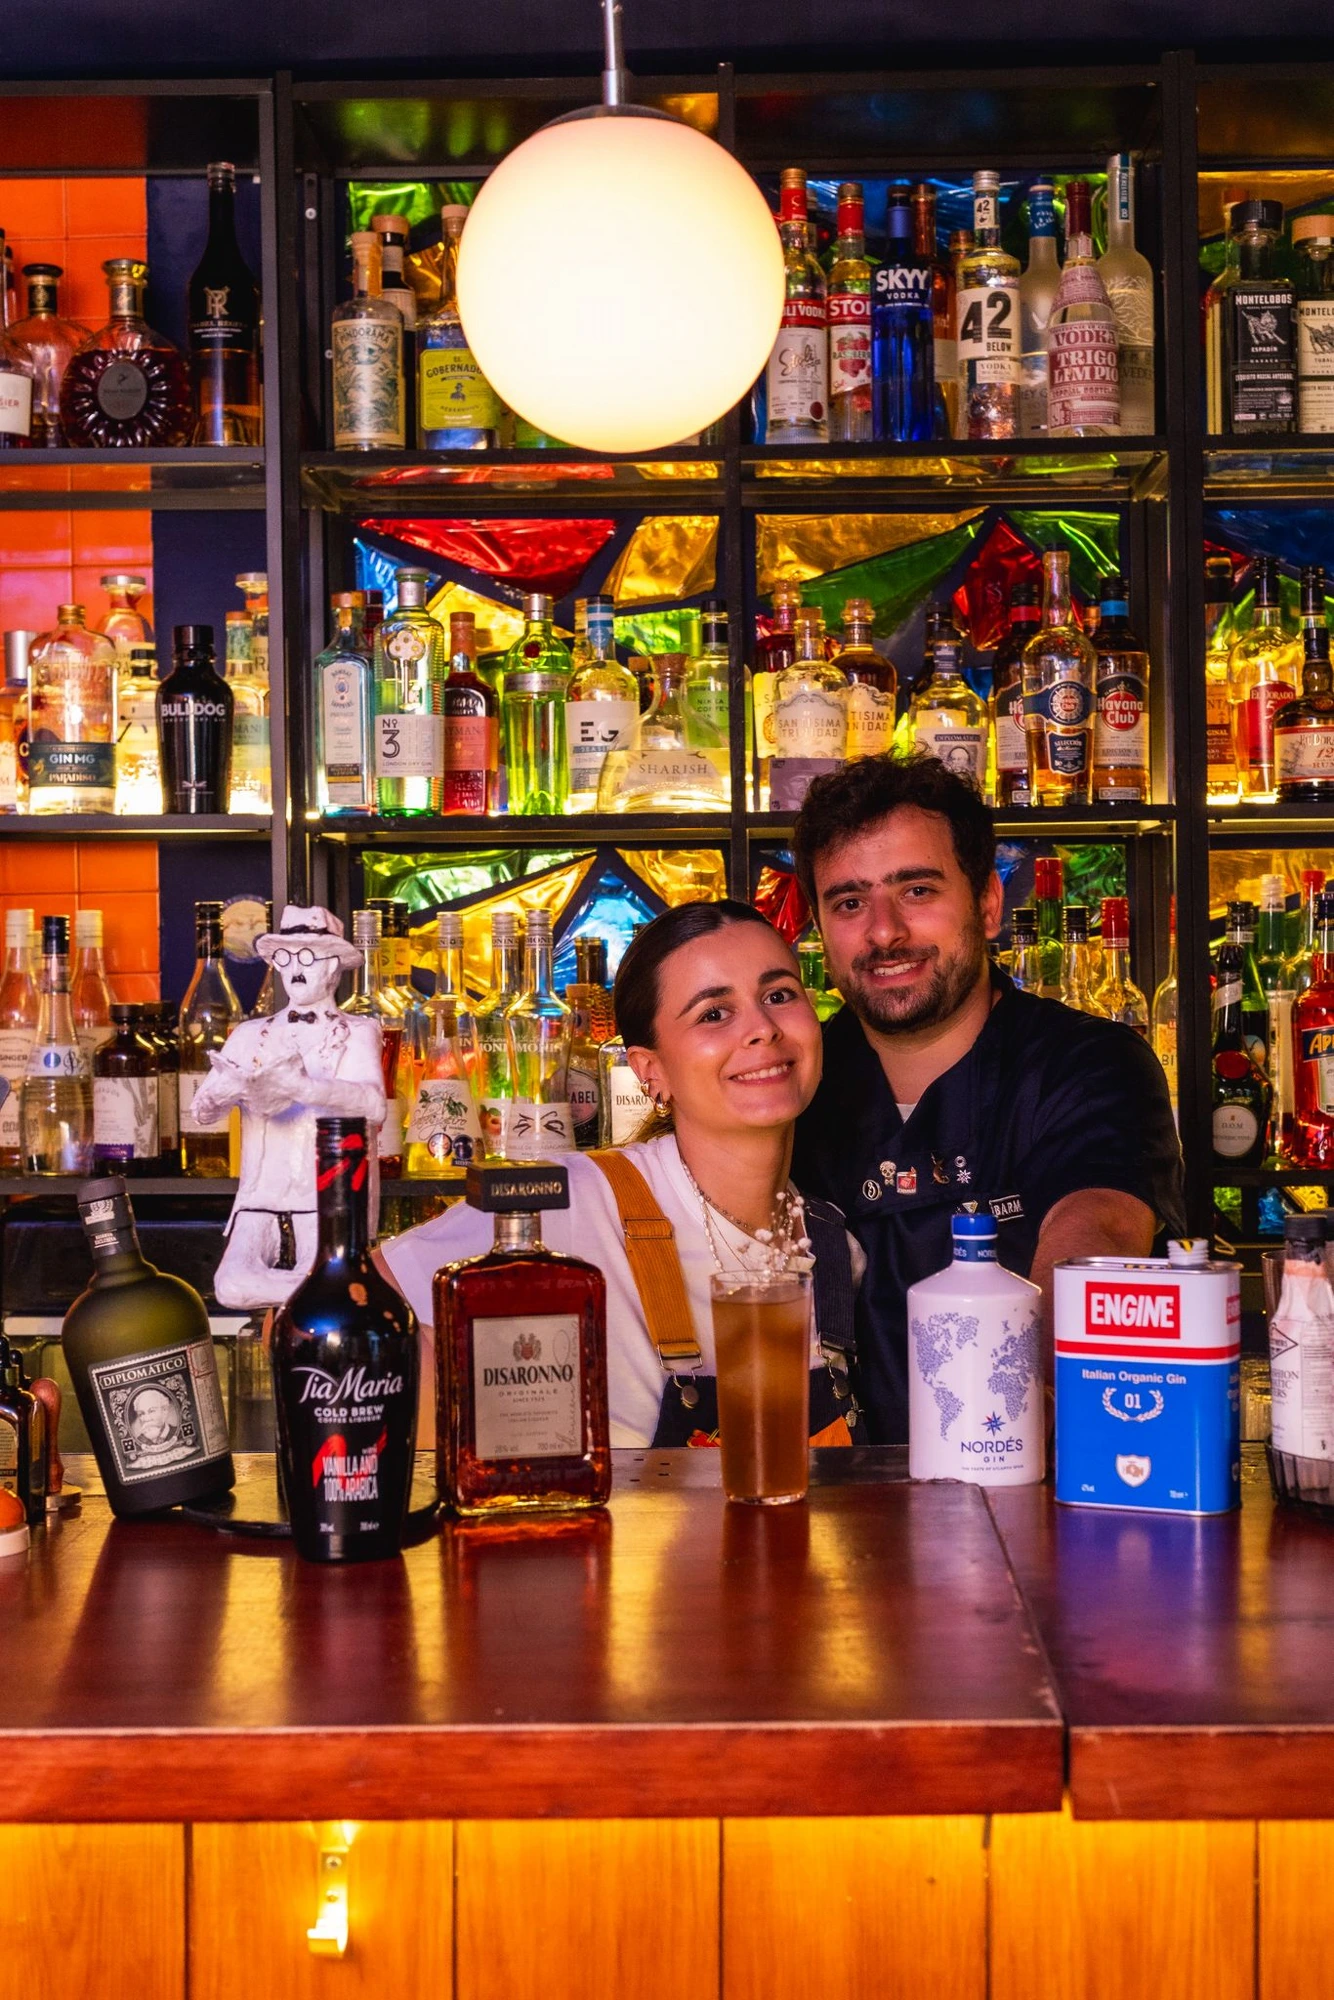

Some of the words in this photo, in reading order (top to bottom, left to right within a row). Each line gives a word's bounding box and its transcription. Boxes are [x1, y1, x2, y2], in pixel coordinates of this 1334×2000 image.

[976, 200, 990, 213] 42
[876, 268, 929, 292] SKYY
[886, 292, 920, 300] VODKA
[1235, 294, 1293, 305] MONTELOBOS
[960, 290, 1013, 343] 42
[1054, 328, 1117, 347] VODKA
[986, 342, 1012, 352] BELOW
[980, 362, 1012, 371] VODKA
[1056, 349, 1118, 369] TRIGO
[426, 363, 483, 378] GOBERNADO
[1053, 365, 1120, 386] LIMPIO
[1264, 690, 1295, 700] DORADO
[161, 702, 226, 717] BULLDOG
[1097, 697, 1144, 711] Havana
[1265, 700, 1276, 719] 5
[1106, 710, 1136, 725] Club
[382, 729, 401, 758] 3
[50, 754, 72, 764] GIN
[74, 754, 95, 764] MG
[1316, 747, 1334, 758] 12
[639, 763, 708, 775] SHARISH
[491, 1180, 563, 1197] DISARONNO
[1090, 1292, 1175, 1329] ENGINE
[103, 1357, 184, 1388] DIPLOMÁTICO
[483, 1363, 574, 1387] DISARONNO
[1082, 1368, 1116, 1381] Italian
[1118, 1370, 1164, 1385] Organic
[1166, 1373, 1187, 1385] Gin
[327, 1366, 404, 1406] Maria
[499, 1388, 559, 1398] ORIGINALE
[1124, 1392, 1142, 1410] 01
[314, 1407, 348, 1418] COLD
[350, 1404, 385, 1417] BREW
[317, 1416, 347, 1424] COFFEE
[348, 1414, 382, 1423] LIQUEUR
[960, 1436, 1024, 1454] NORDÉS
[321, 1455, 359, 1477] VANILLA
[360, 1453, 379, 1476] AND
[983, 1455, 1005, 1463] GIN
[345, 1475, 379, 1501] ARABICA
